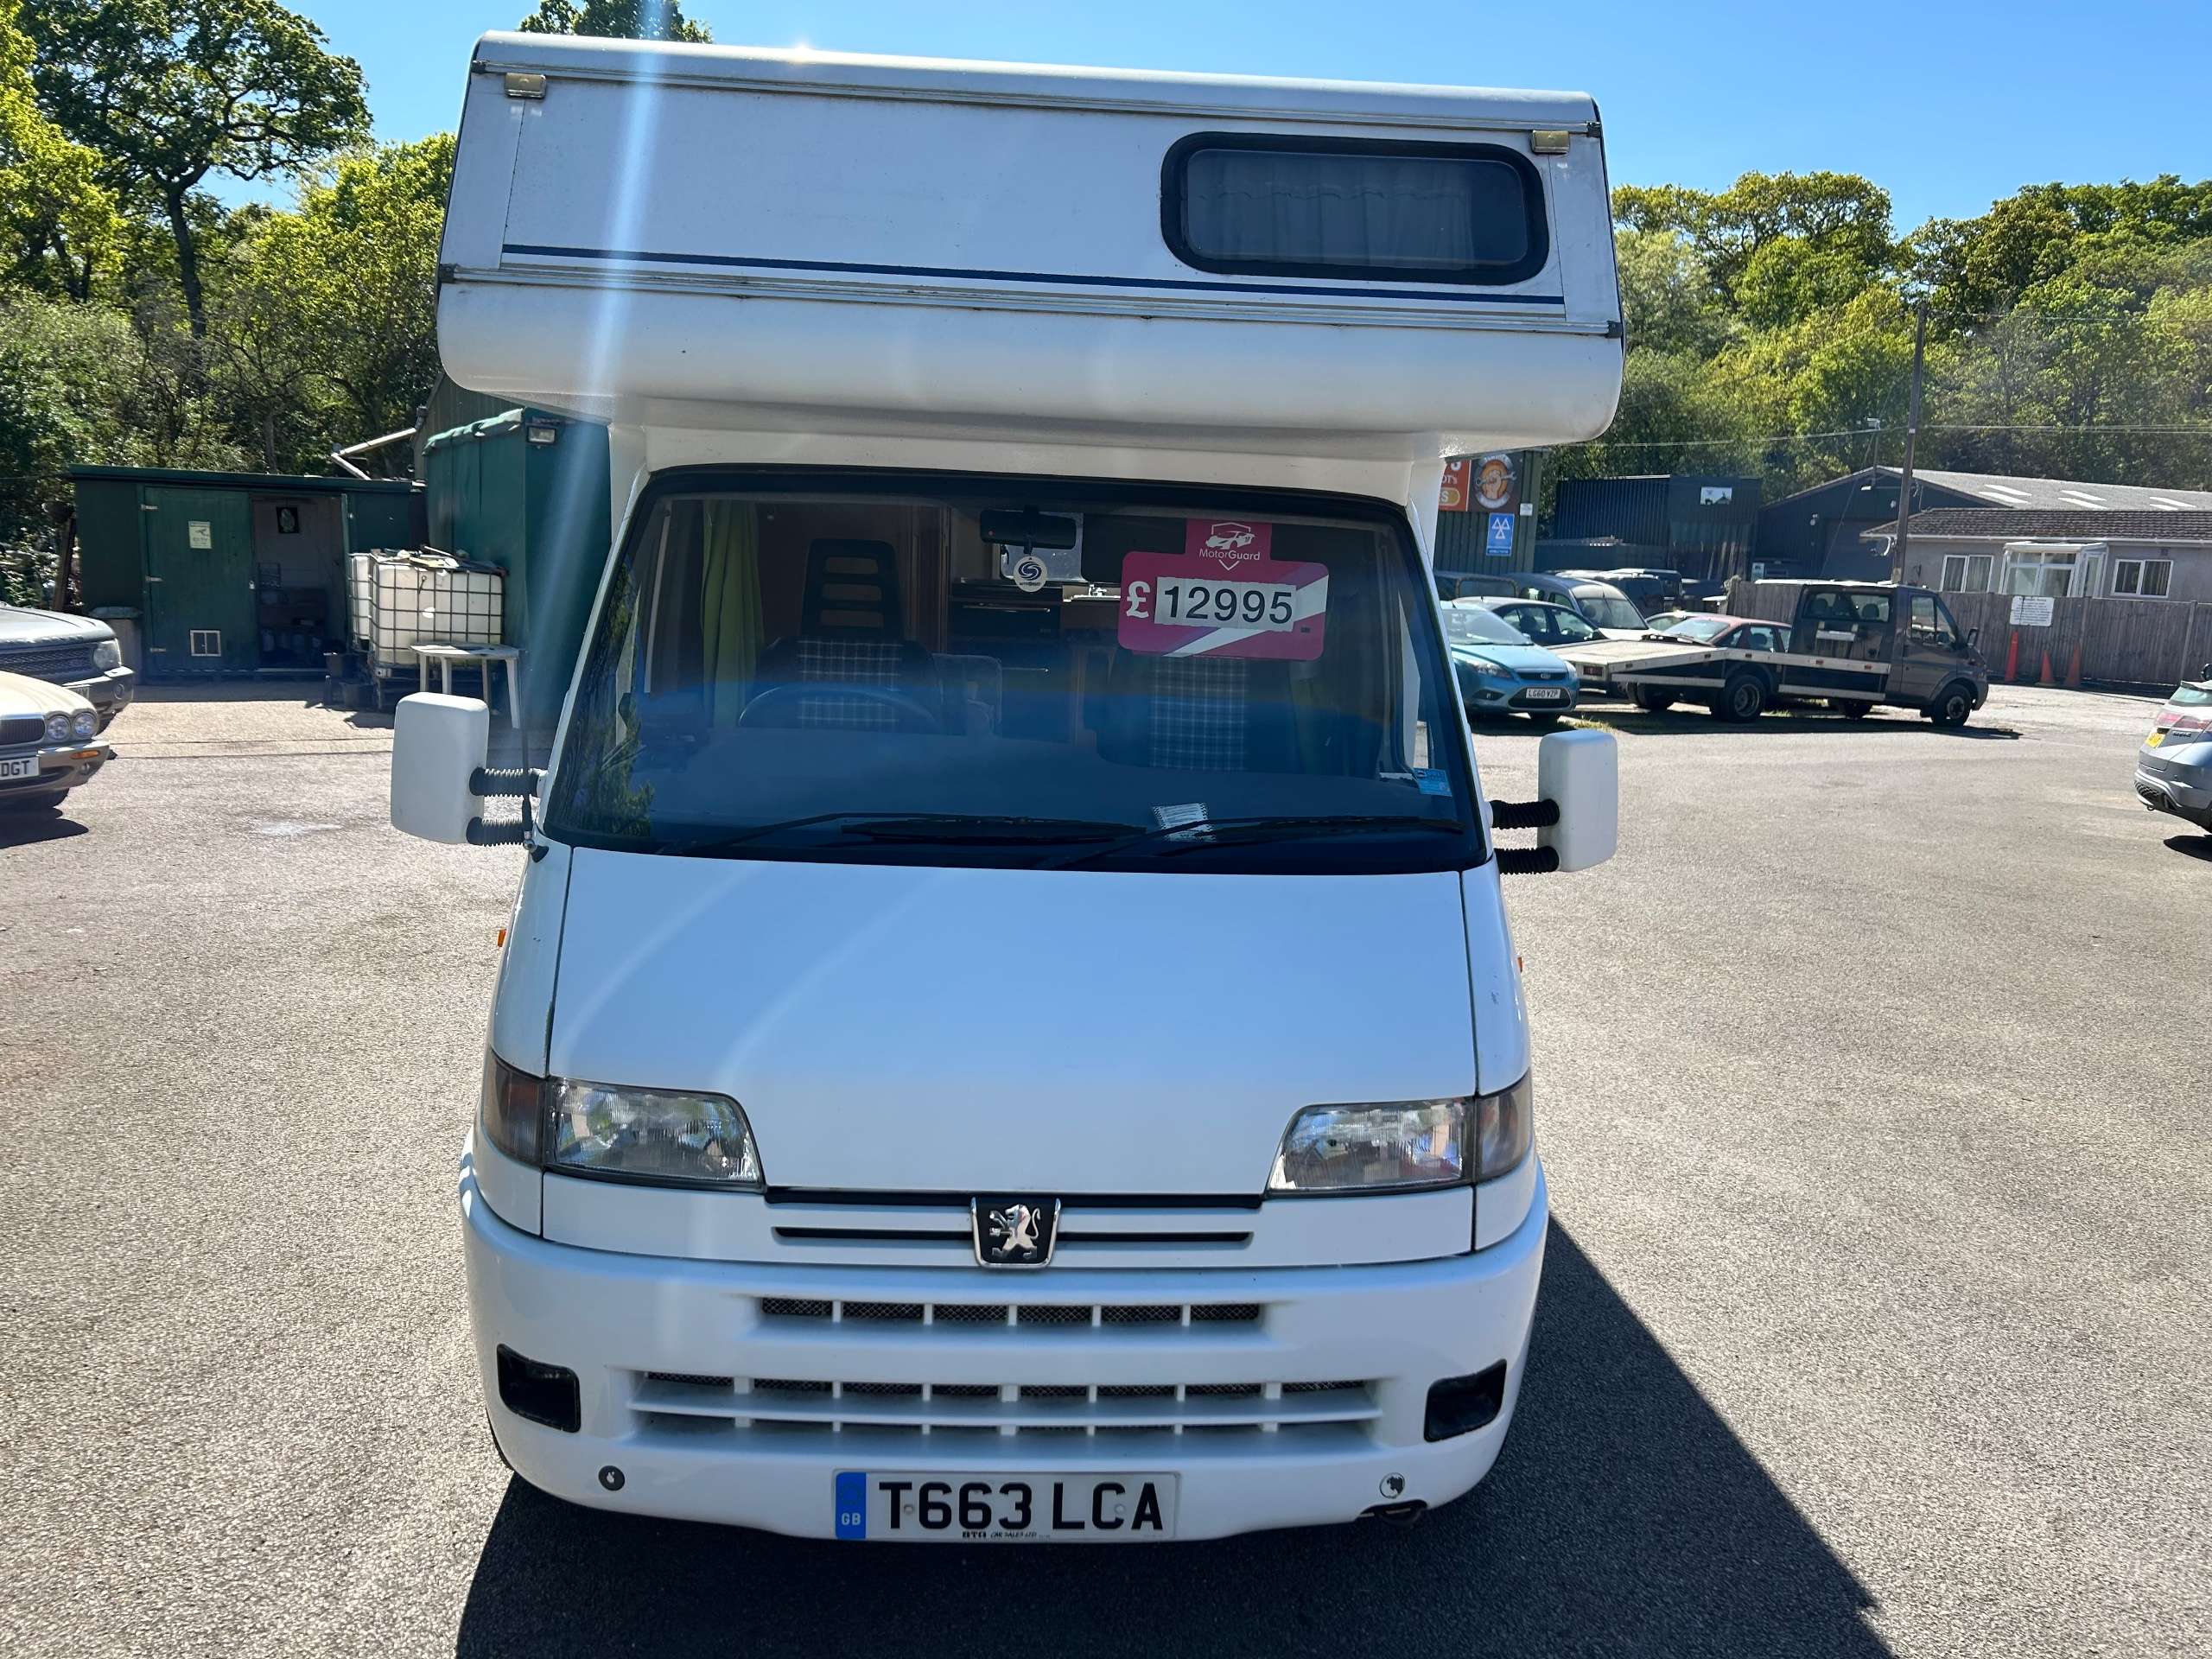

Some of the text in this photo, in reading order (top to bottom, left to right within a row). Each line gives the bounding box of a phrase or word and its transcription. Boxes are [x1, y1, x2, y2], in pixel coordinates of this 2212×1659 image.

[1199, 548, 1262, 561] MotorGuard
[1126, 581, 1294, 625] £ 12995
[0, 760, 30, 777] DGT
[879, 1481, 1164, 1530] T663 LCA
[841, 1512, 861, 1526] GB
